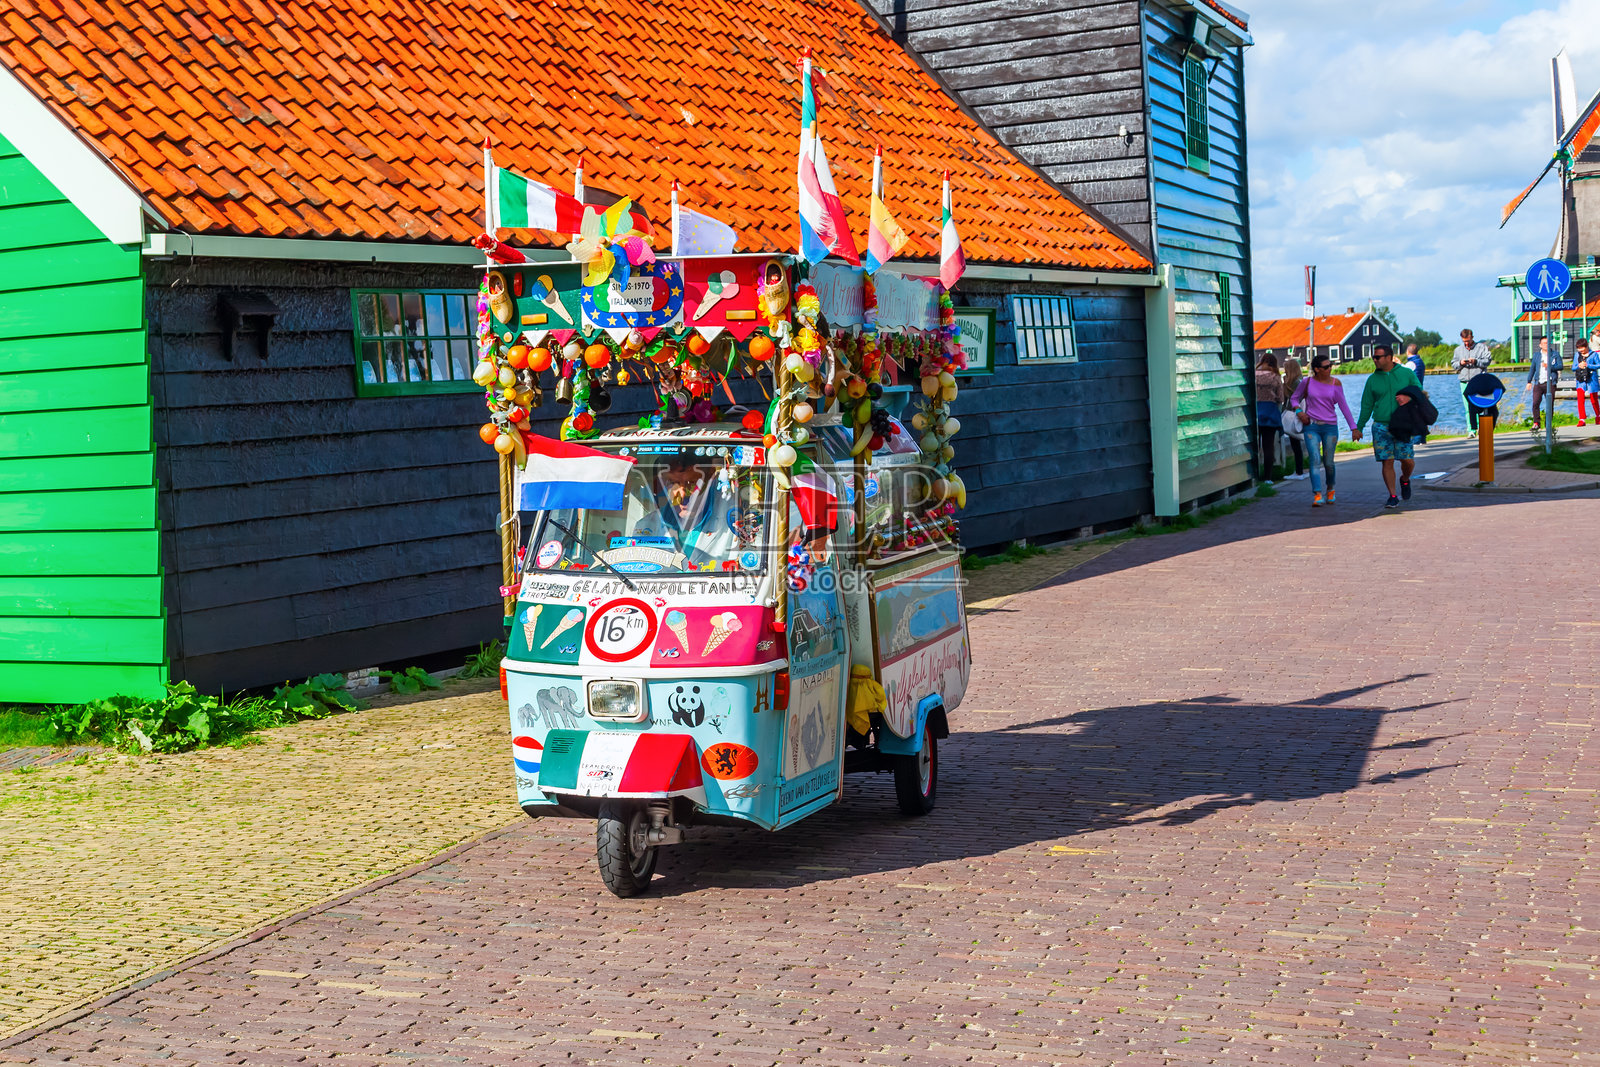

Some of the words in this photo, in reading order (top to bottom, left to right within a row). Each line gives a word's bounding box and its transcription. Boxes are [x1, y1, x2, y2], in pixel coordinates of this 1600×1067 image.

[572, 579, 625, 595] GELATI
[635, 581, 737, 596] NAPOLETANI
[600, 616, 625, 643] 16
[626, 615, 644, 629] km
[649, 718, 673, 727] WNF
